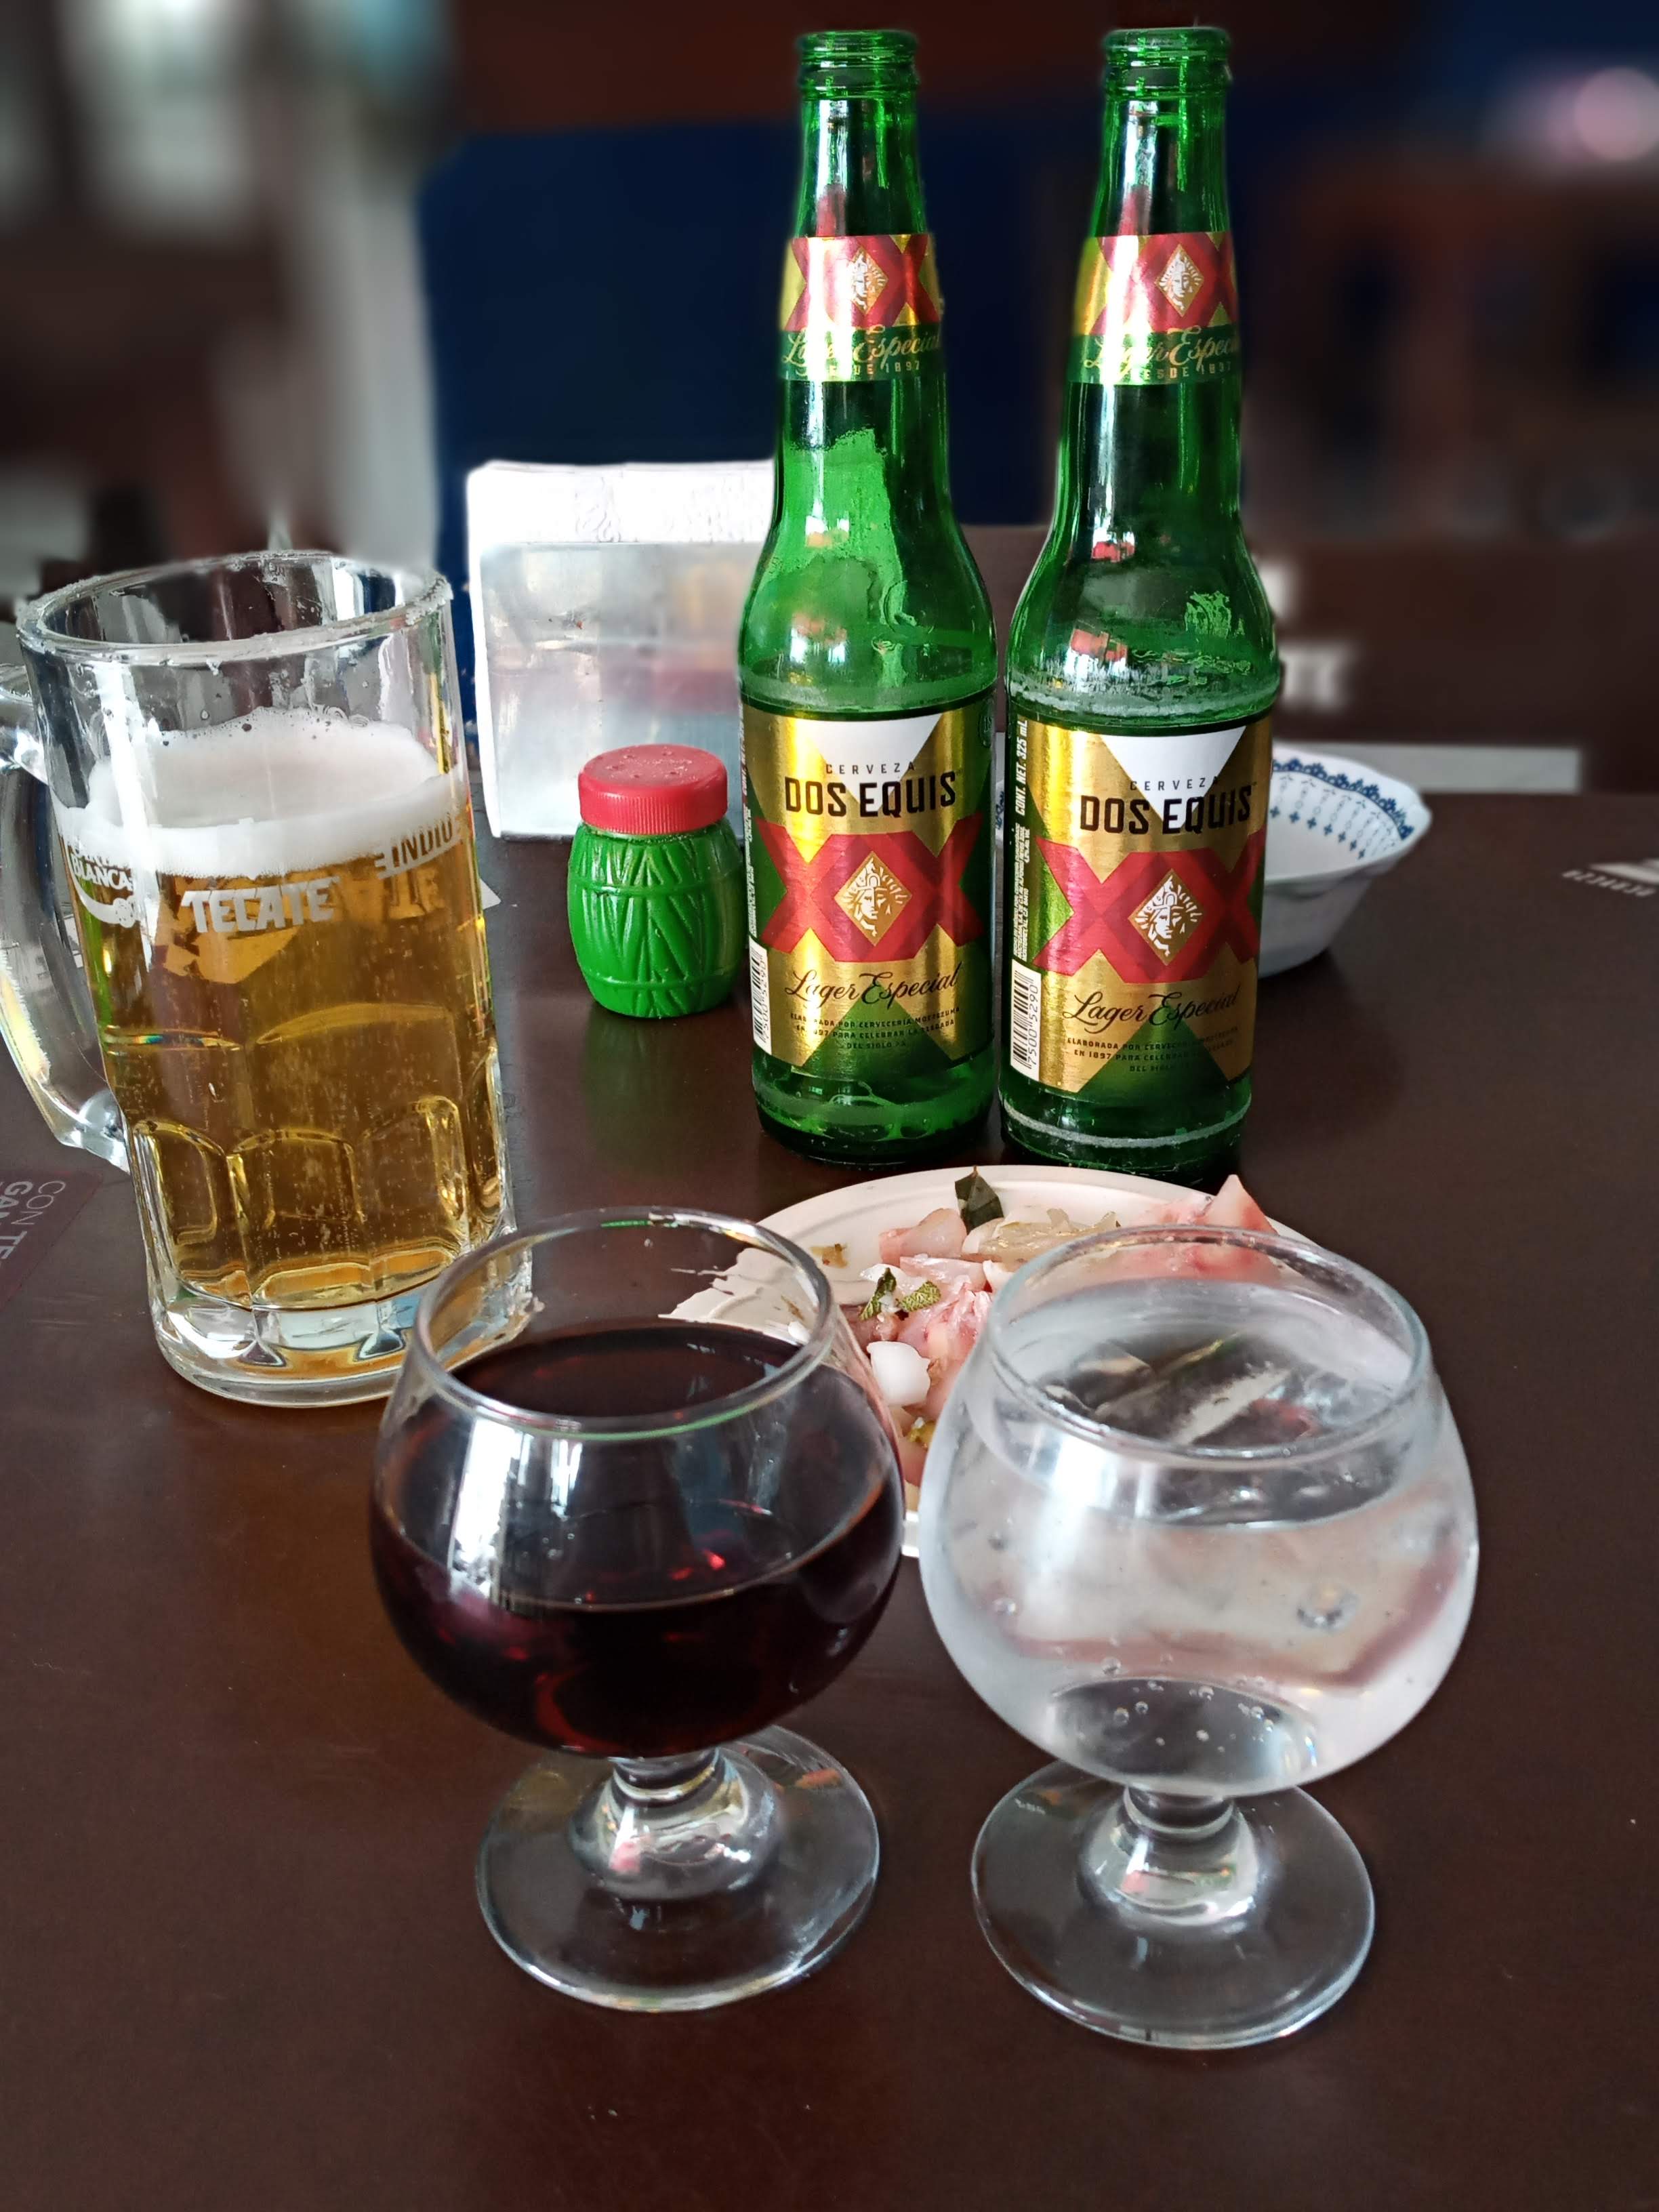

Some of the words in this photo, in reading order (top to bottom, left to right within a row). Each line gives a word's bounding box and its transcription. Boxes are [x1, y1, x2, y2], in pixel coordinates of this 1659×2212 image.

[886, 361, 920, 373] 1897
[1017, 720, 1028, 737] mL
[1016, 736, 1027, 760] 325
[825, 762, 916, 775] CERVEZA
[1015, 761, 1027, 785] NET.
[1129, 776, 1220, 791] CERVEZA
[785, 776, 846, 817] DOS
[859, 771, 956, 818] EQUIS
[1015, 785, 1026, 816] CONT.
[1080, 794, 1150, 835] DOS
[1162, 784, 1252, 835] EQUIS
[180, 876, 341, 933] TECATE
[785, 969, 860, 1009] Lager
[859, 960, 962, 1010] Especial
[1029, 984, 1039, 1022] 5290
[1062, 991, 1150, 1034] Lager
[1148, 984, 1241, 1031] Especial
[1028, 1028, 1038, 1065] 7500
[1067, 1038, 1119, 1050] ELABORADA
[1088, 1050, 1111, 1059] 1897
[10, 1180, 66, 1225] CON
